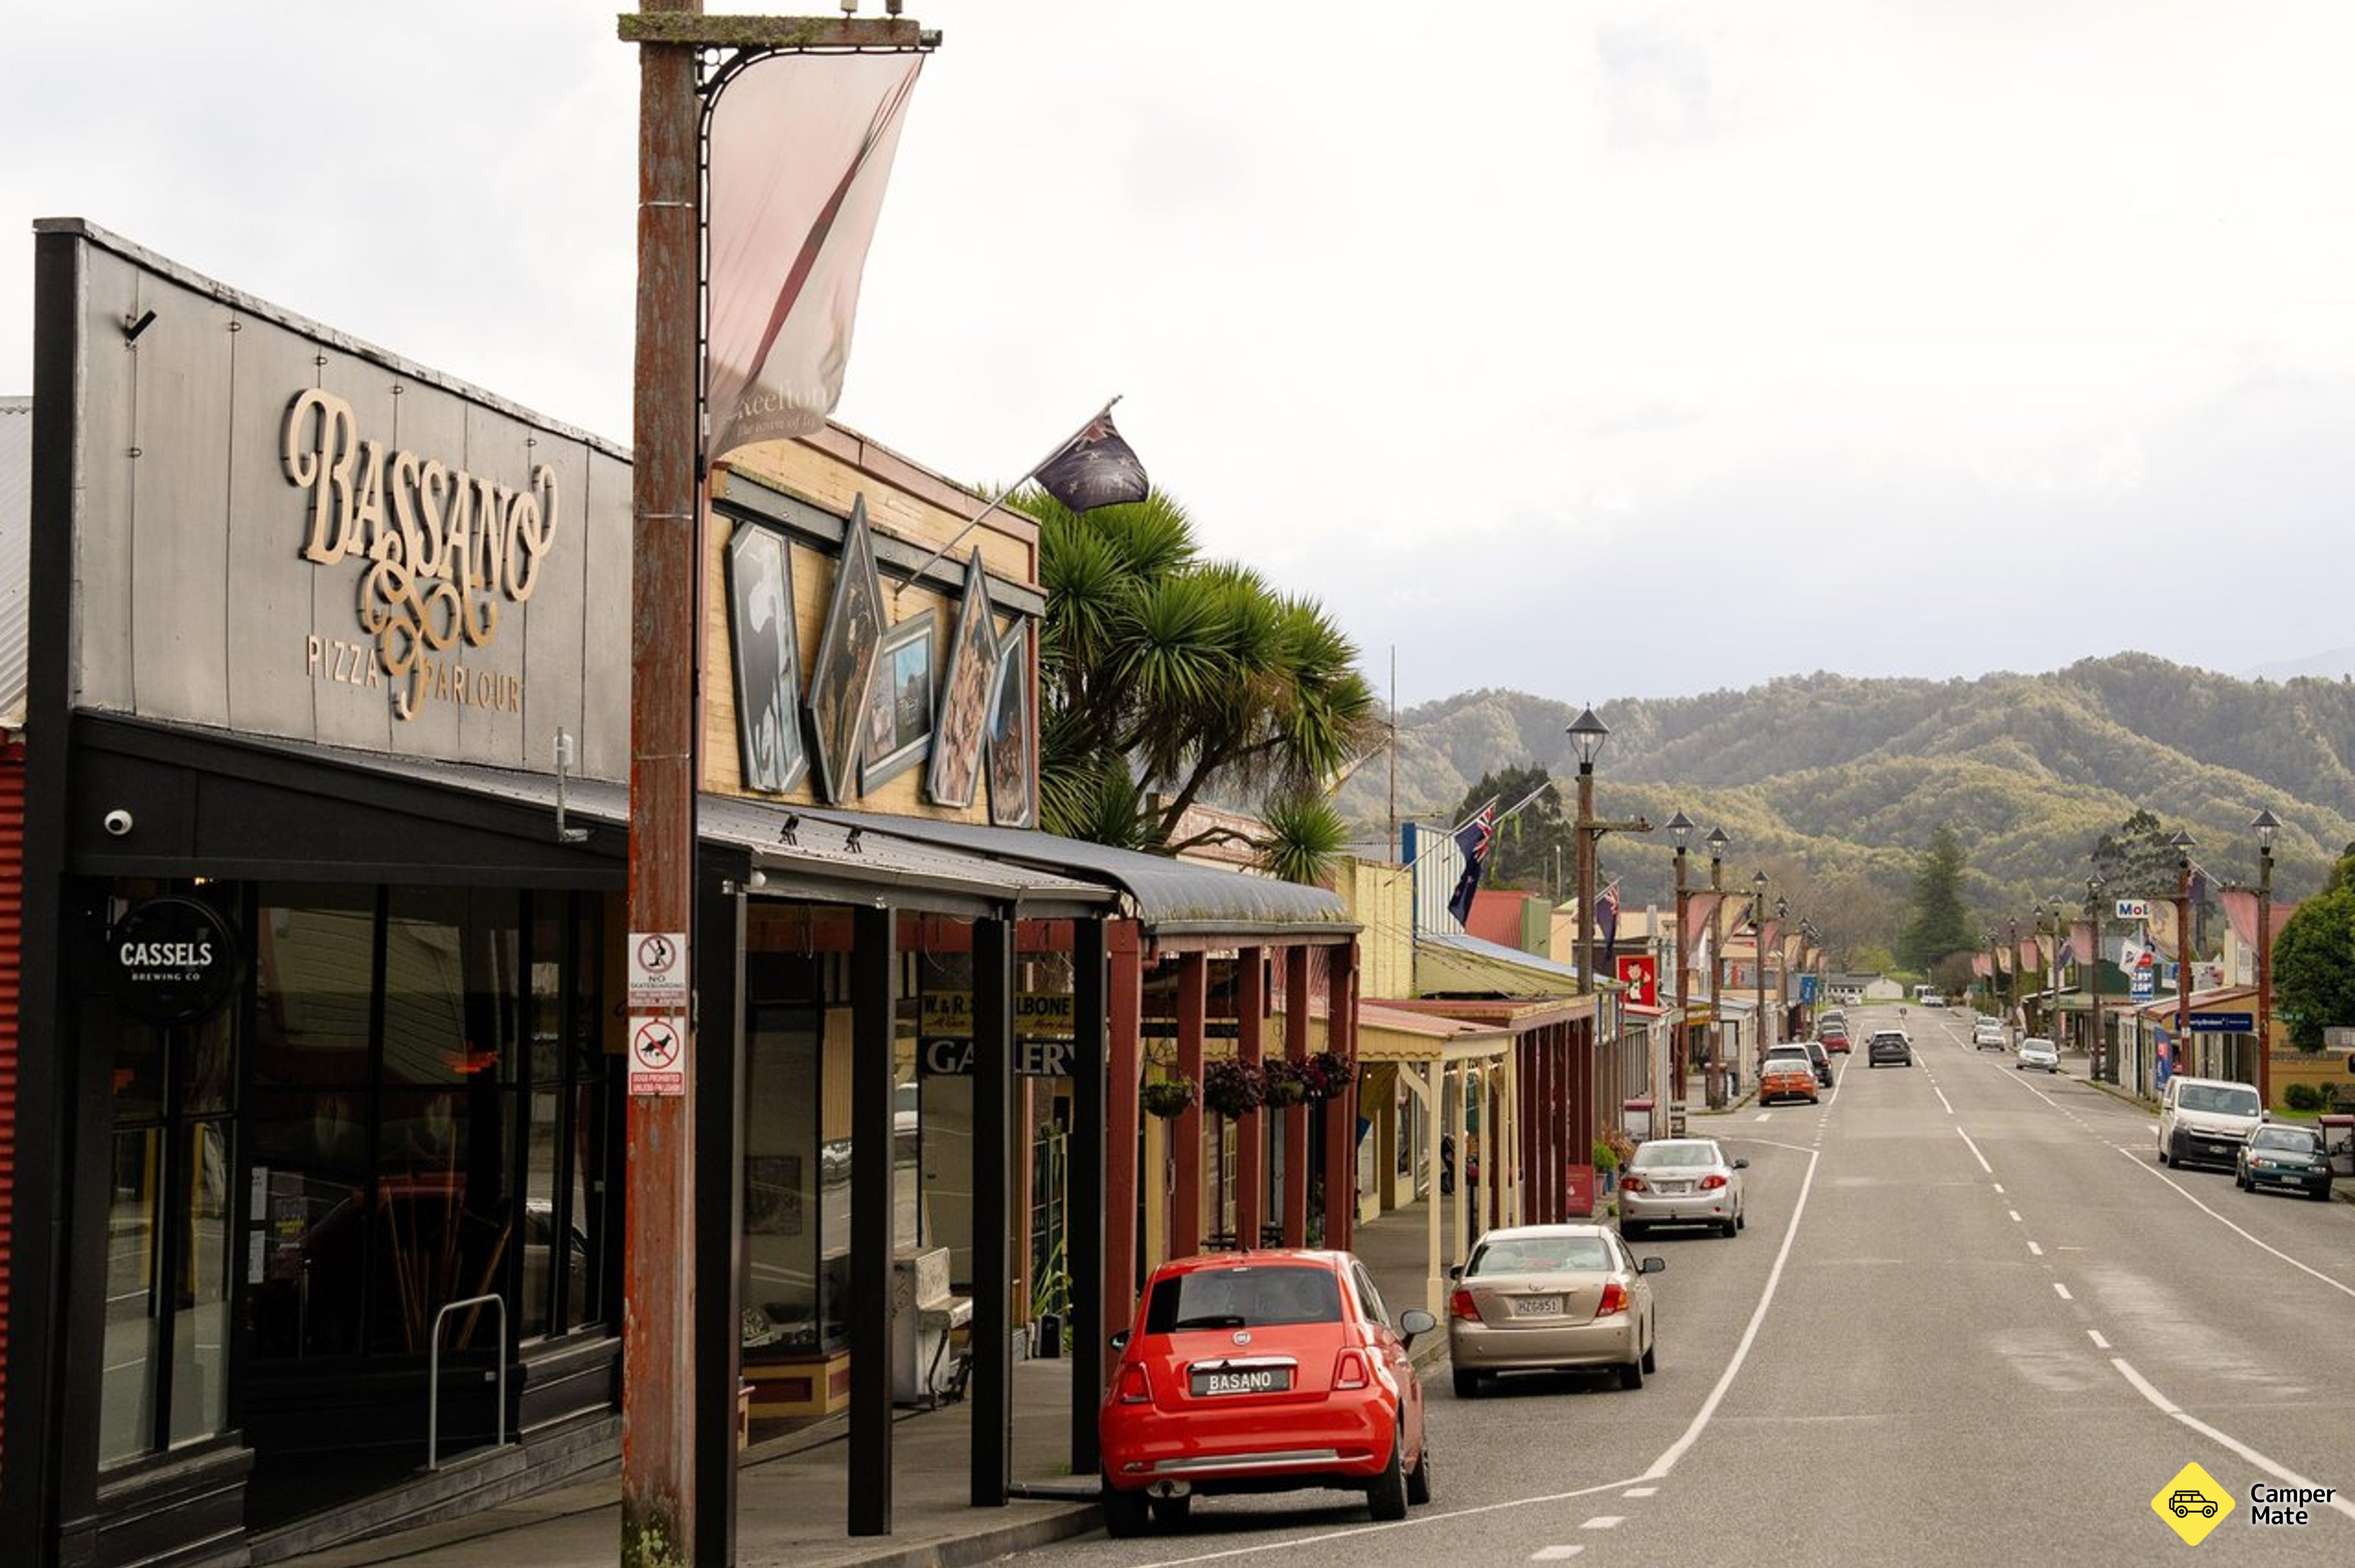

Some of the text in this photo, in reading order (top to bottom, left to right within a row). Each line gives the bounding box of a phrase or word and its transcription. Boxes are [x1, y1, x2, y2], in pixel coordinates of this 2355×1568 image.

[307, 635, 520, 713] PIZZA PARLOUR
[121, 942, 213, 965] CASSELS
[132, 973, 201, 982] BREWING CO
[927, 1040, 1075, 1075] GAER
[1210, 1372, 1271, 1390] BASANO
